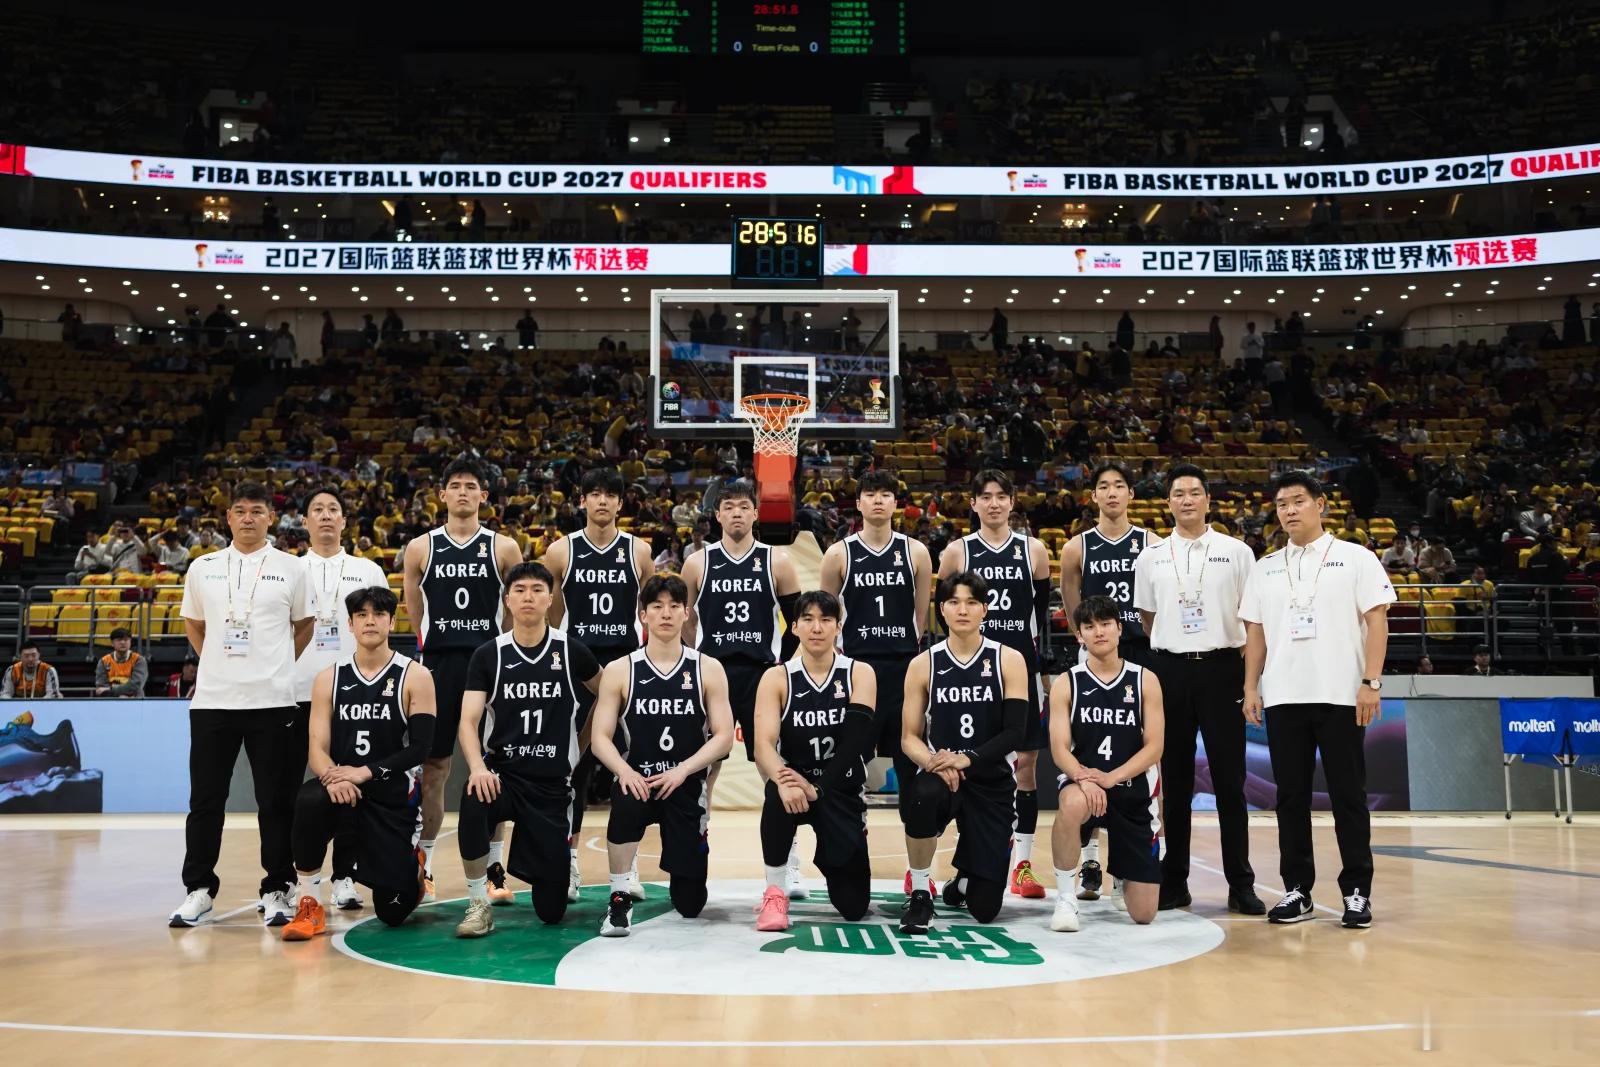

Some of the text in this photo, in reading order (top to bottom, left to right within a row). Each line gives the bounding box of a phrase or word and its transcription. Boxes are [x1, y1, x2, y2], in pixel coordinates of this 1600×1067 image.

[756, 24, 796, 32] Time-outs
[733, 41, 743, 52] 0
[752, 44, 801, 52] Team Fouls
[809, 42, 819, 52] 0
[192, 165, 767, 190] FIBA BASKETBALL WORLD CUP 2027 QUALIFIERS
[1064, 173, 1118, 190] FIBA
[1124, 173, 1278, 190] BASKETBALL
[1285, 170, 1370, 189] WORLD
[1376, 167, 1429, 185] CUP
[1435, 160, 1504, 182] 2027
[265, 247, 649, 271] 2027国际篮联篮球世界杯预选赛
[1142, 238, 1538, 273] 2027国际篮联篮球世界杯预选赛
[664, 403, 679, 411] FIBA
[435, 563, 488, 579] KOREA
[575, 569, 627, 584] KOREA
[854, 572, 905, 587] KOREA
[973, 566, 1024, 580] KOREA
[711, 578, 762, 593] KOREA
[1105, 582, 1131, 602] 23
[454, 587, 470, 609] 0
[589, 593, 613, 615] 10
[875, 596, 885, 617] 1
[986, 588, 1012, 611] 26
[724, 601, 750, 624] 33
[1119, 610, 1143, 624] 나은행
[450, 619, 490, 631] 하나은행
[589, 623, 627, 636] 하나은행
[871, 626, 906, 638] 하나은행
[988, 619, 1025, 632] 하나은행
[726, 631, 762, 644] 하나은행
[503, 682, 562, 700] KOREA
[936, 686, 994, 704] KOREA
[339, 703, 391, 720] KOREA
[635, 698, 695, 715] KOREA
[520, 708, 543, 735] 11
[1080, 706, 1136, 726] KOREA
[959, 713, 975, 739] 8
[1508, 718, 1556, 733] molten
[1572, 719, 1600, 733] molt
[355, 730, 371, 756] 5
[659, 726, 674, 751] 6
[518, 744, 557, 758] 하나은행
[809, 736, 835, 761] 12
[1097, 735, 1113, 761] 4
